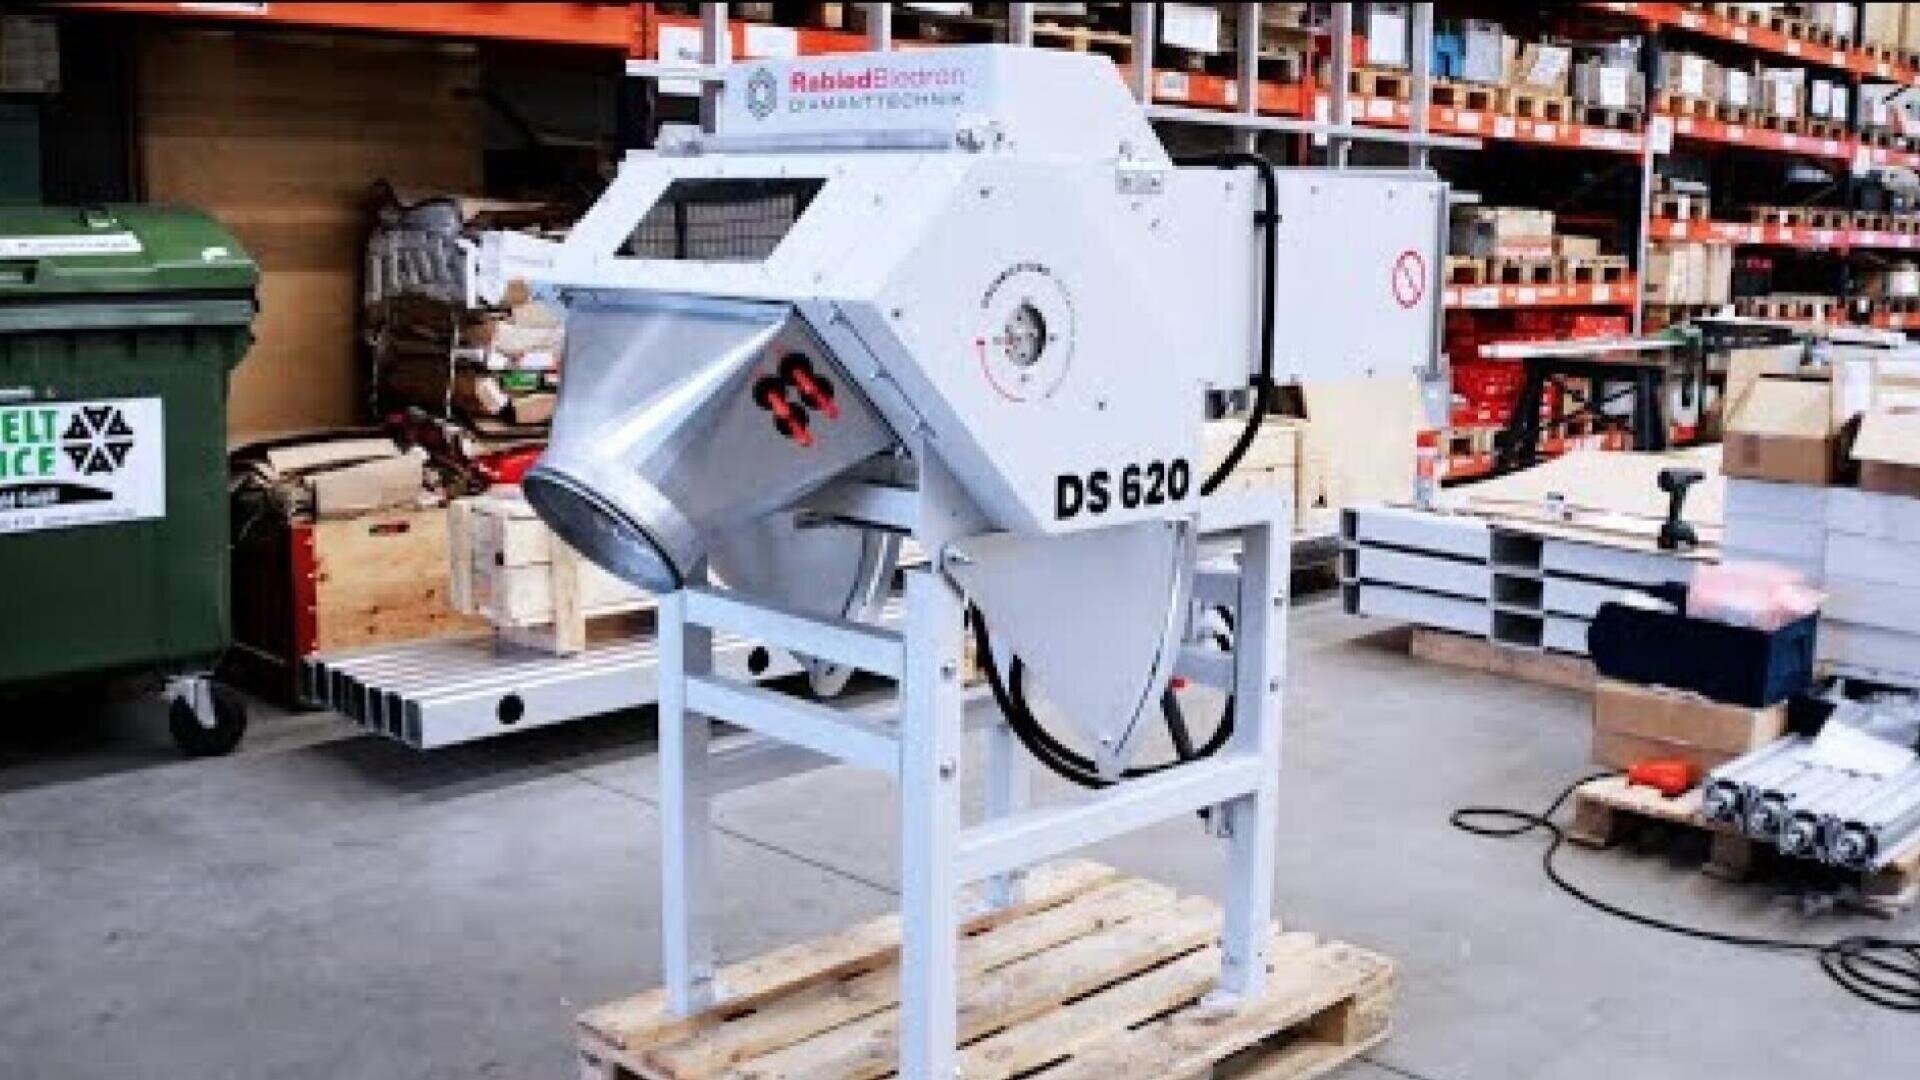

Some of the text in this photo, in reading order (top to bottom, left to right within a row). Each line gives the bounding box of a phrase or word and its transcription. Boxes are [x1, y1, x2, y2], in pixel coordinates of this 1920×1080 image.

[1, 409, 58, 444] ELT
[1054, 457, 1190, 520] DS 620
